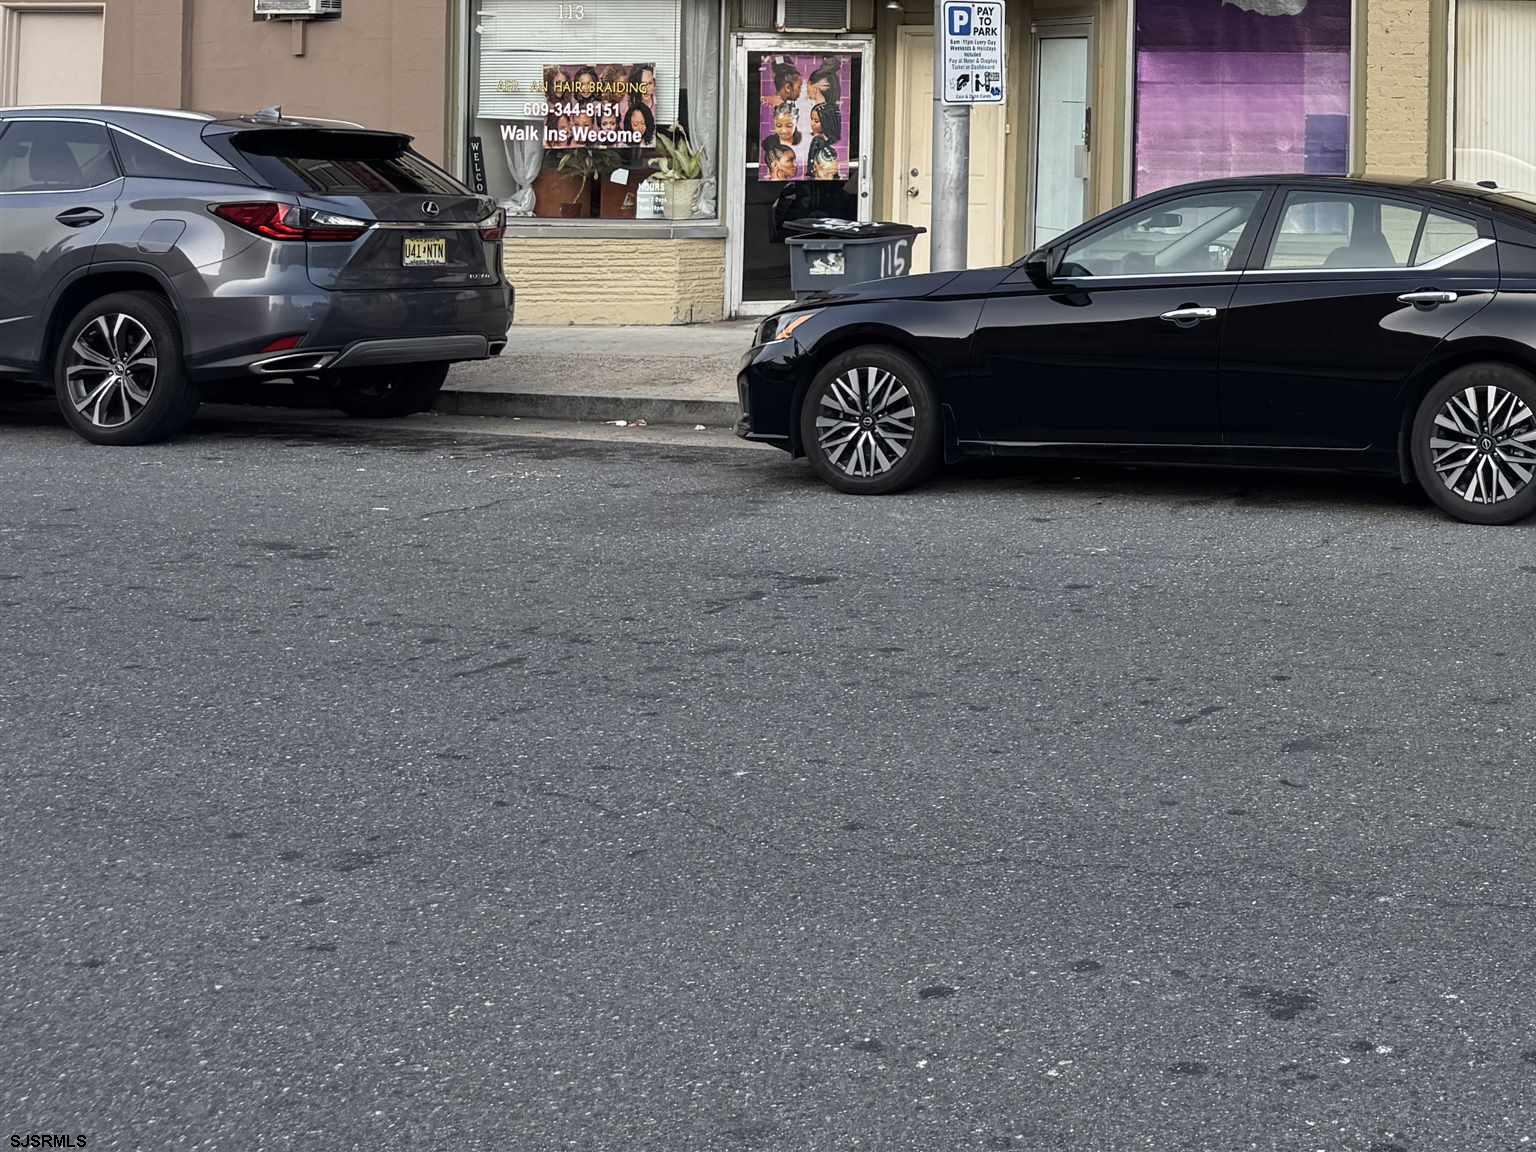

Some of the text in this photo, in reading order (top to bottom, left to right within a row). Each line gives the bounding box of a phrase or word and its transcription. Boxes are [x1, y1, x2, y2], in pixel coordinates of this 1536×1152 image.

[558, 2, 585, 20] 113
[977, 6, 994, 16] PAY
[979, 17, 992, 26] TO
[973, 27, 998, 36] PARK
[554, 81, 583, 93] HAIR
[589, 81, 648, 94] BRAIDING
[523, 102, 620, 117] 609-344-8151
[500, 125, 642, 143] Walk Ins Wecome
[471, 142, 484, 192] WELCO
[881, 239, 907, 279] 115
